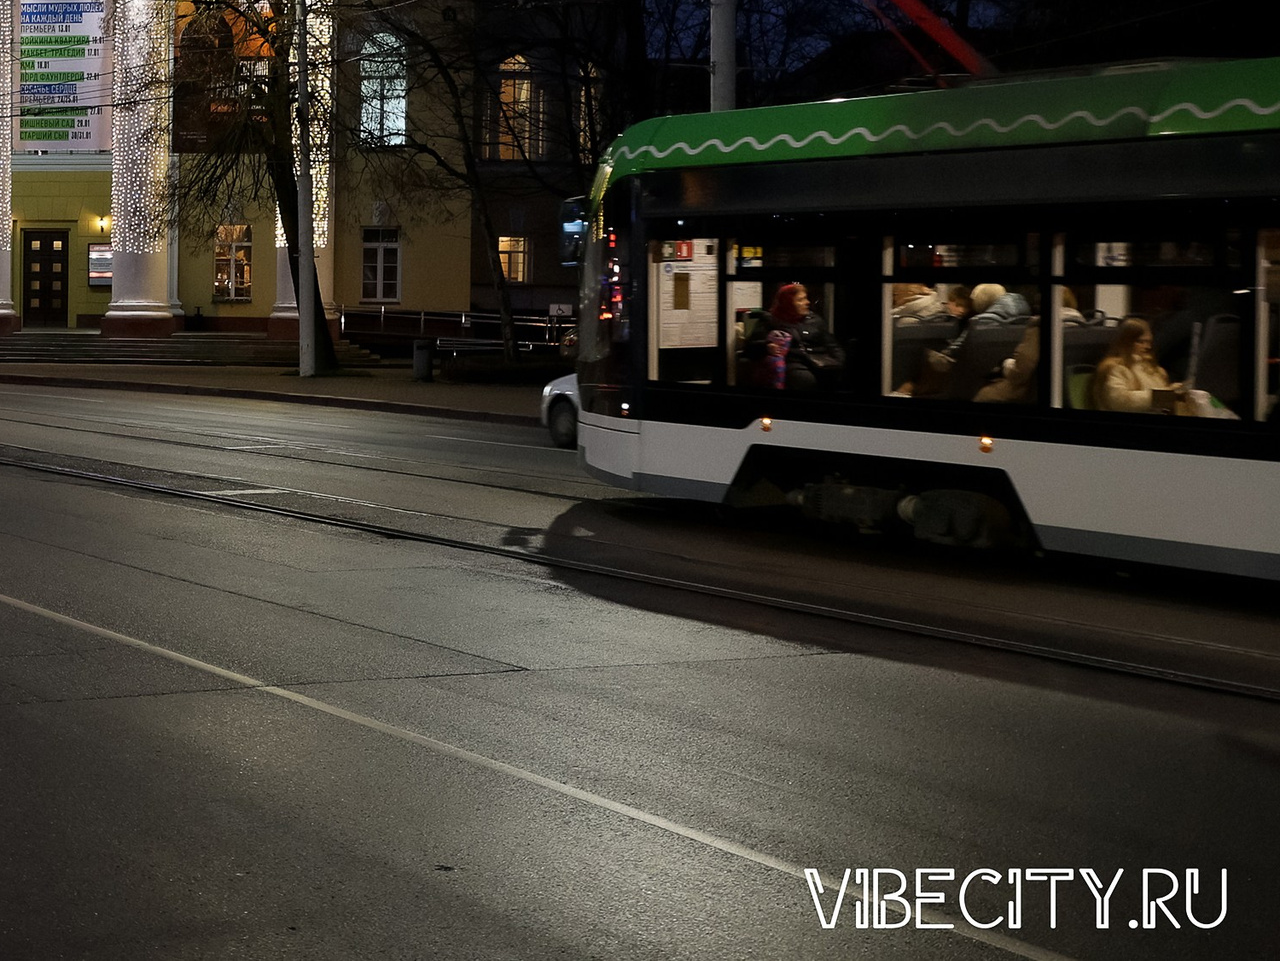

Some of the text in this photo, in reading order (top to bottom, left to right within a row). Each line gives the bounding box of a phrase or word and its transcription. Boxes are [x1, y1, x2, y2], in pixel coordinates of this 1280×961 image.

[21, 4, 48, 13] МЫСЛИ
[48, 3, 79, 13] МУДРЫХ
[21, 13, 83, 24] НА КАЖДЫЙ ДЕНЬ
[21, 25, 71, 34] ПРЕМЬЕРА 13.01
[21, 35, 53, 45] ЗОЙКИНА
[54, 35, 90, 45] КВАРТИРА
[51, 47, 86, 57] ТРАГЕДИЯ
[21, 60, 35, 69] ЯМА
[21, 72, 39, 82] ЛОРД
[40, 71, 85, 82] ФАУНТЛЕРОЙ
[21, 84, 77, 94] СОБАЧЬЕ СЕРДЦЕ
[21, 96, 56, 104] ПРЕМЬЕРА
[20, 118, 60, 128] ВИШНЕВЫЙ
[62, 119, 76, 128] САД
[20, 130, 53, 140] СТАРШИЙ
[54, 131, 69, 140] СЫН
